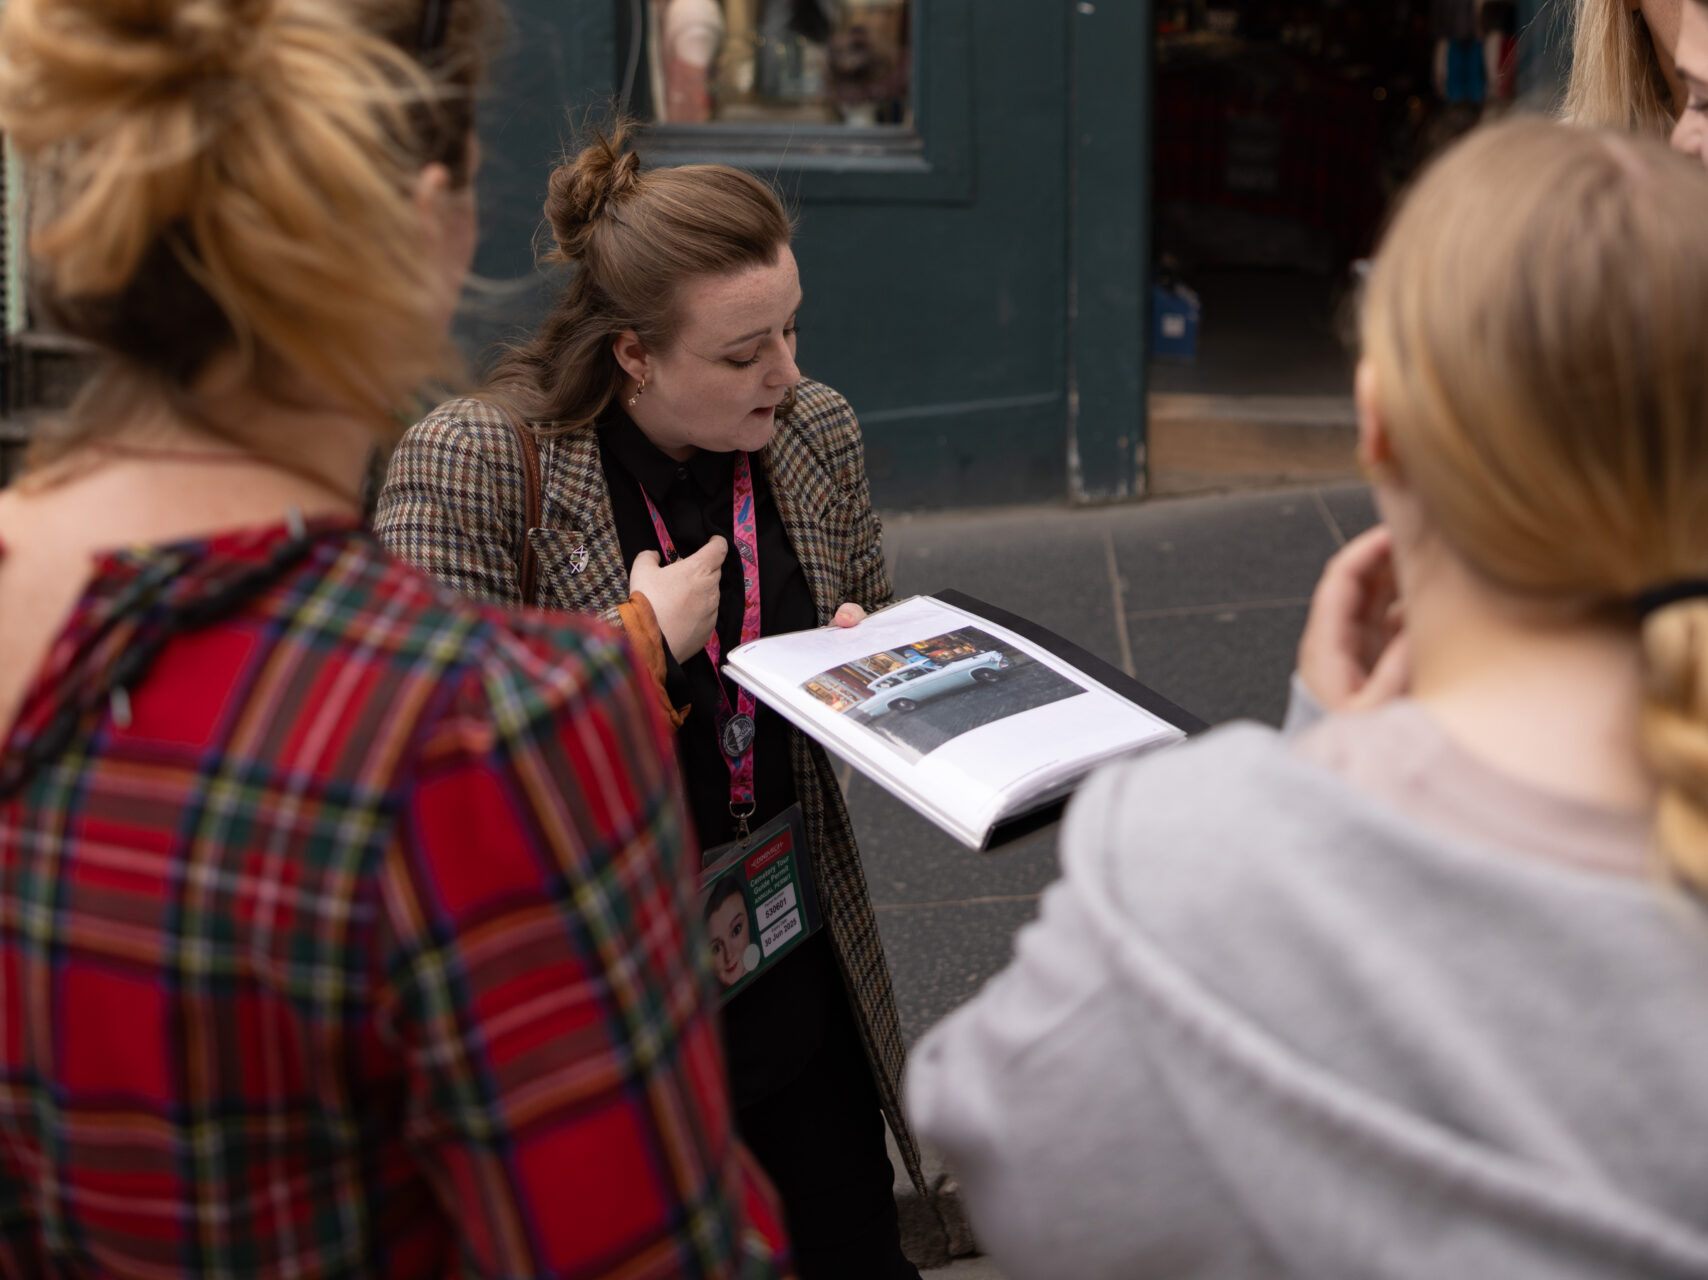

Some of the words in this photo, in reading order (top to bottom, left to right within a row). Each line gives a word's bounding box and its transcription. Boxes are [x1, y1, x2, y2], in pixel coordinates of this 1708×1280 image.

[776, 855, 790, 868] Tour
[754, 879, 770, 895] Guide
[770, 864, 789, 883] Permit
[764, 936, 772, 947] 30
[772, 929, 784, 942] Jun
[783, 917, 798, 933] 2025
